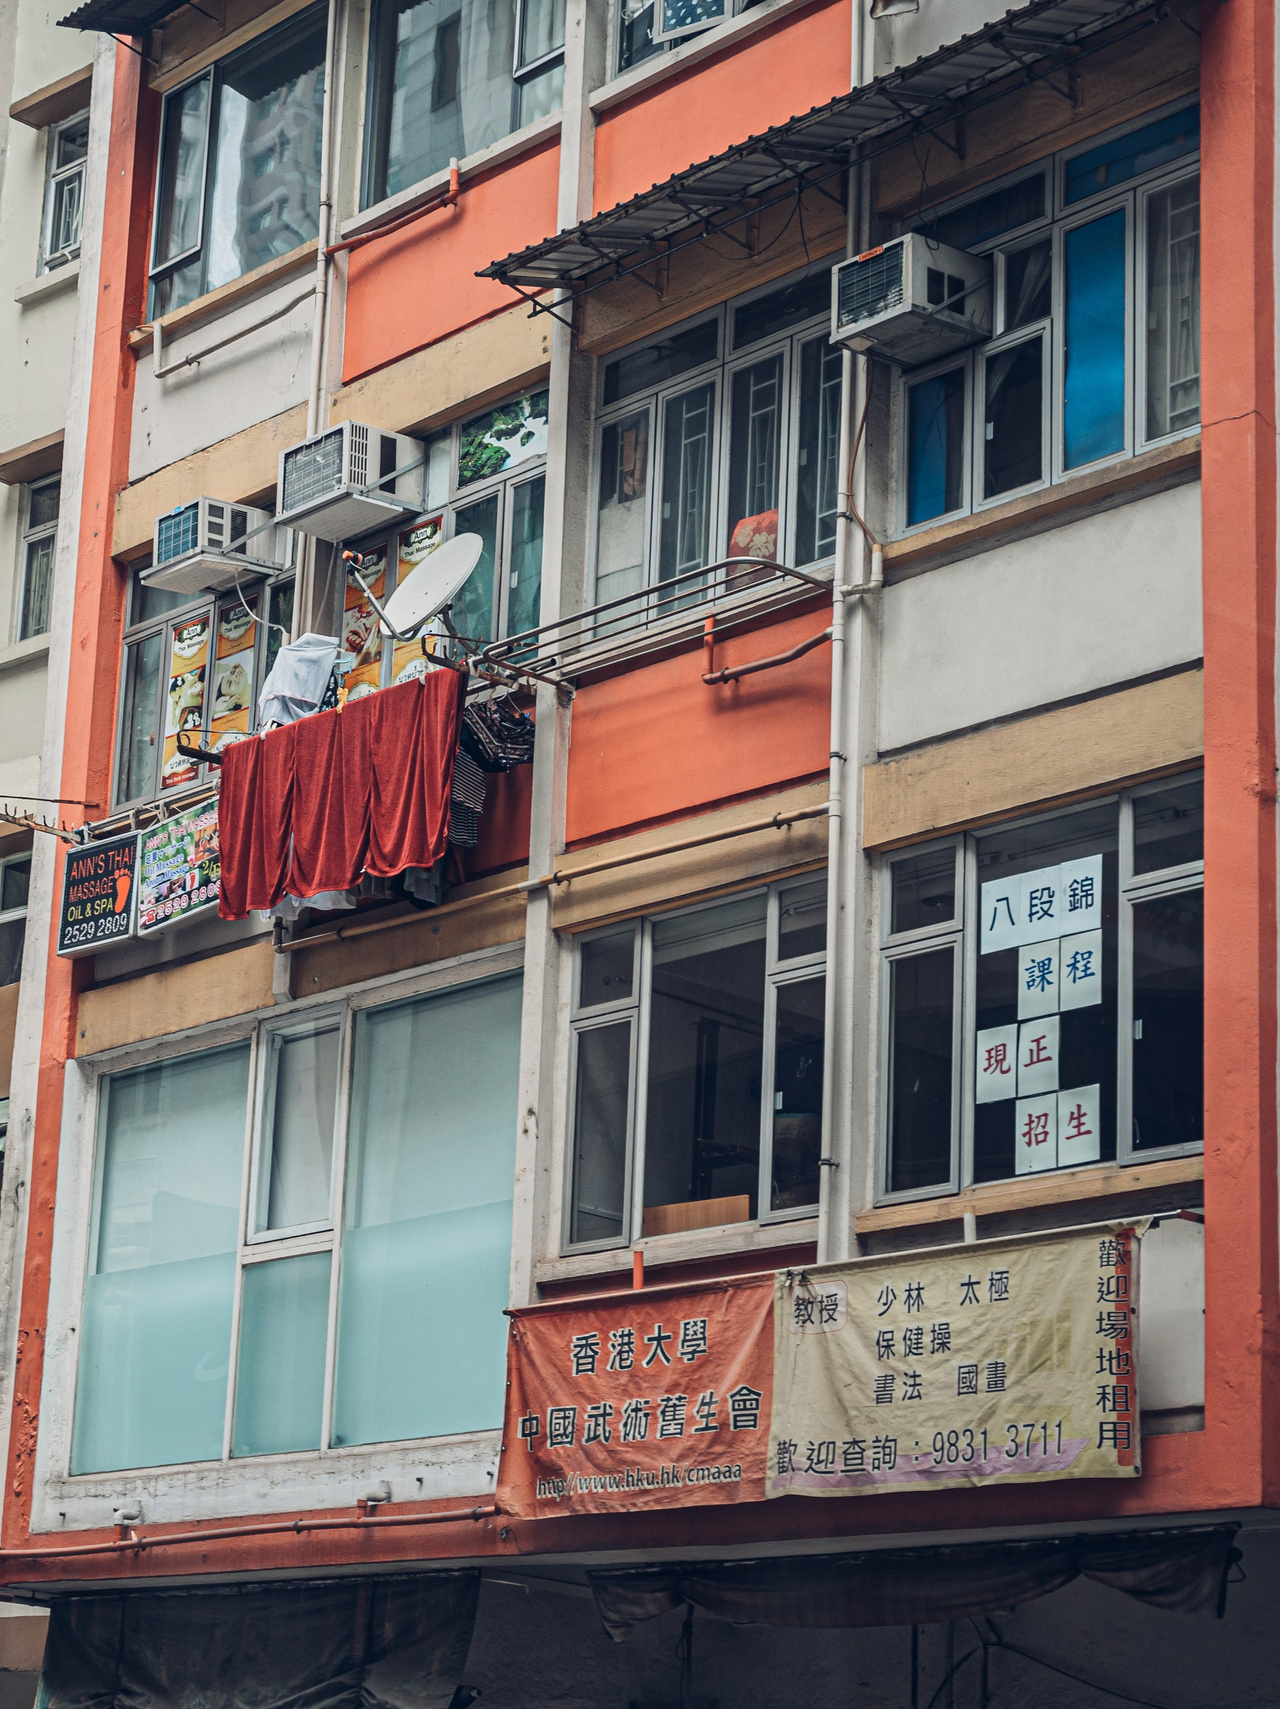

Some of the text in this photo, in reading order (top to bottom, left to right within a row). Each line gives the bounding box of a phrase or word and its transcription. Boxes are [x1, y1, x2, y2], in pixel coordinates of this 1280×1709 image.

[404, 541, 437, 559] Thai Massage
[413, 530, 428, 542] Ann
[232, 608, 245, 618] Ann
[233, 620, 252, 631] Massage
[185, 627, 198, 637] Ann
[187, 638, 205, 649] Massage
[144, 831, 169, 852] ANN'S
[187, 810, 219, 833] MASSAG
[70, 845, 135, 881] ANN'S THAI
[144, 853, 185, 877] Oil Massage
[69, 876, 116, 903] MASSAGE
[84, 903, 92, 918] &
[94, 897, 114, 916] SPA
[988, 875, 1095, 933] 八段錦
[156, 897, 189, 920] 2529
[63, 912, 128, 945] 2529 2809
[1023, 949, 1096, 993] 課程
[982, 1034, 1054, 1076] 現正
[1021, 1103, 1093, 1148] 招生
[793, 1292, 839, 1327] 教授
[876, 1269, 1011, 1318] 少林 太極
[570, 1317, 709, 1377] 香港大學
[874, 1321, 952, 1362] 保健操
[1094, 1238, 1133, 1451] 歡迎場地租用
[873, 1360, 1009, 1406] 書法 國畫
[517, 1384, 764, 1453] 中國武術舊生會
[931, 1425, 989, 1466] 9831
[1004, 1418, 1064, 1460] 3711
